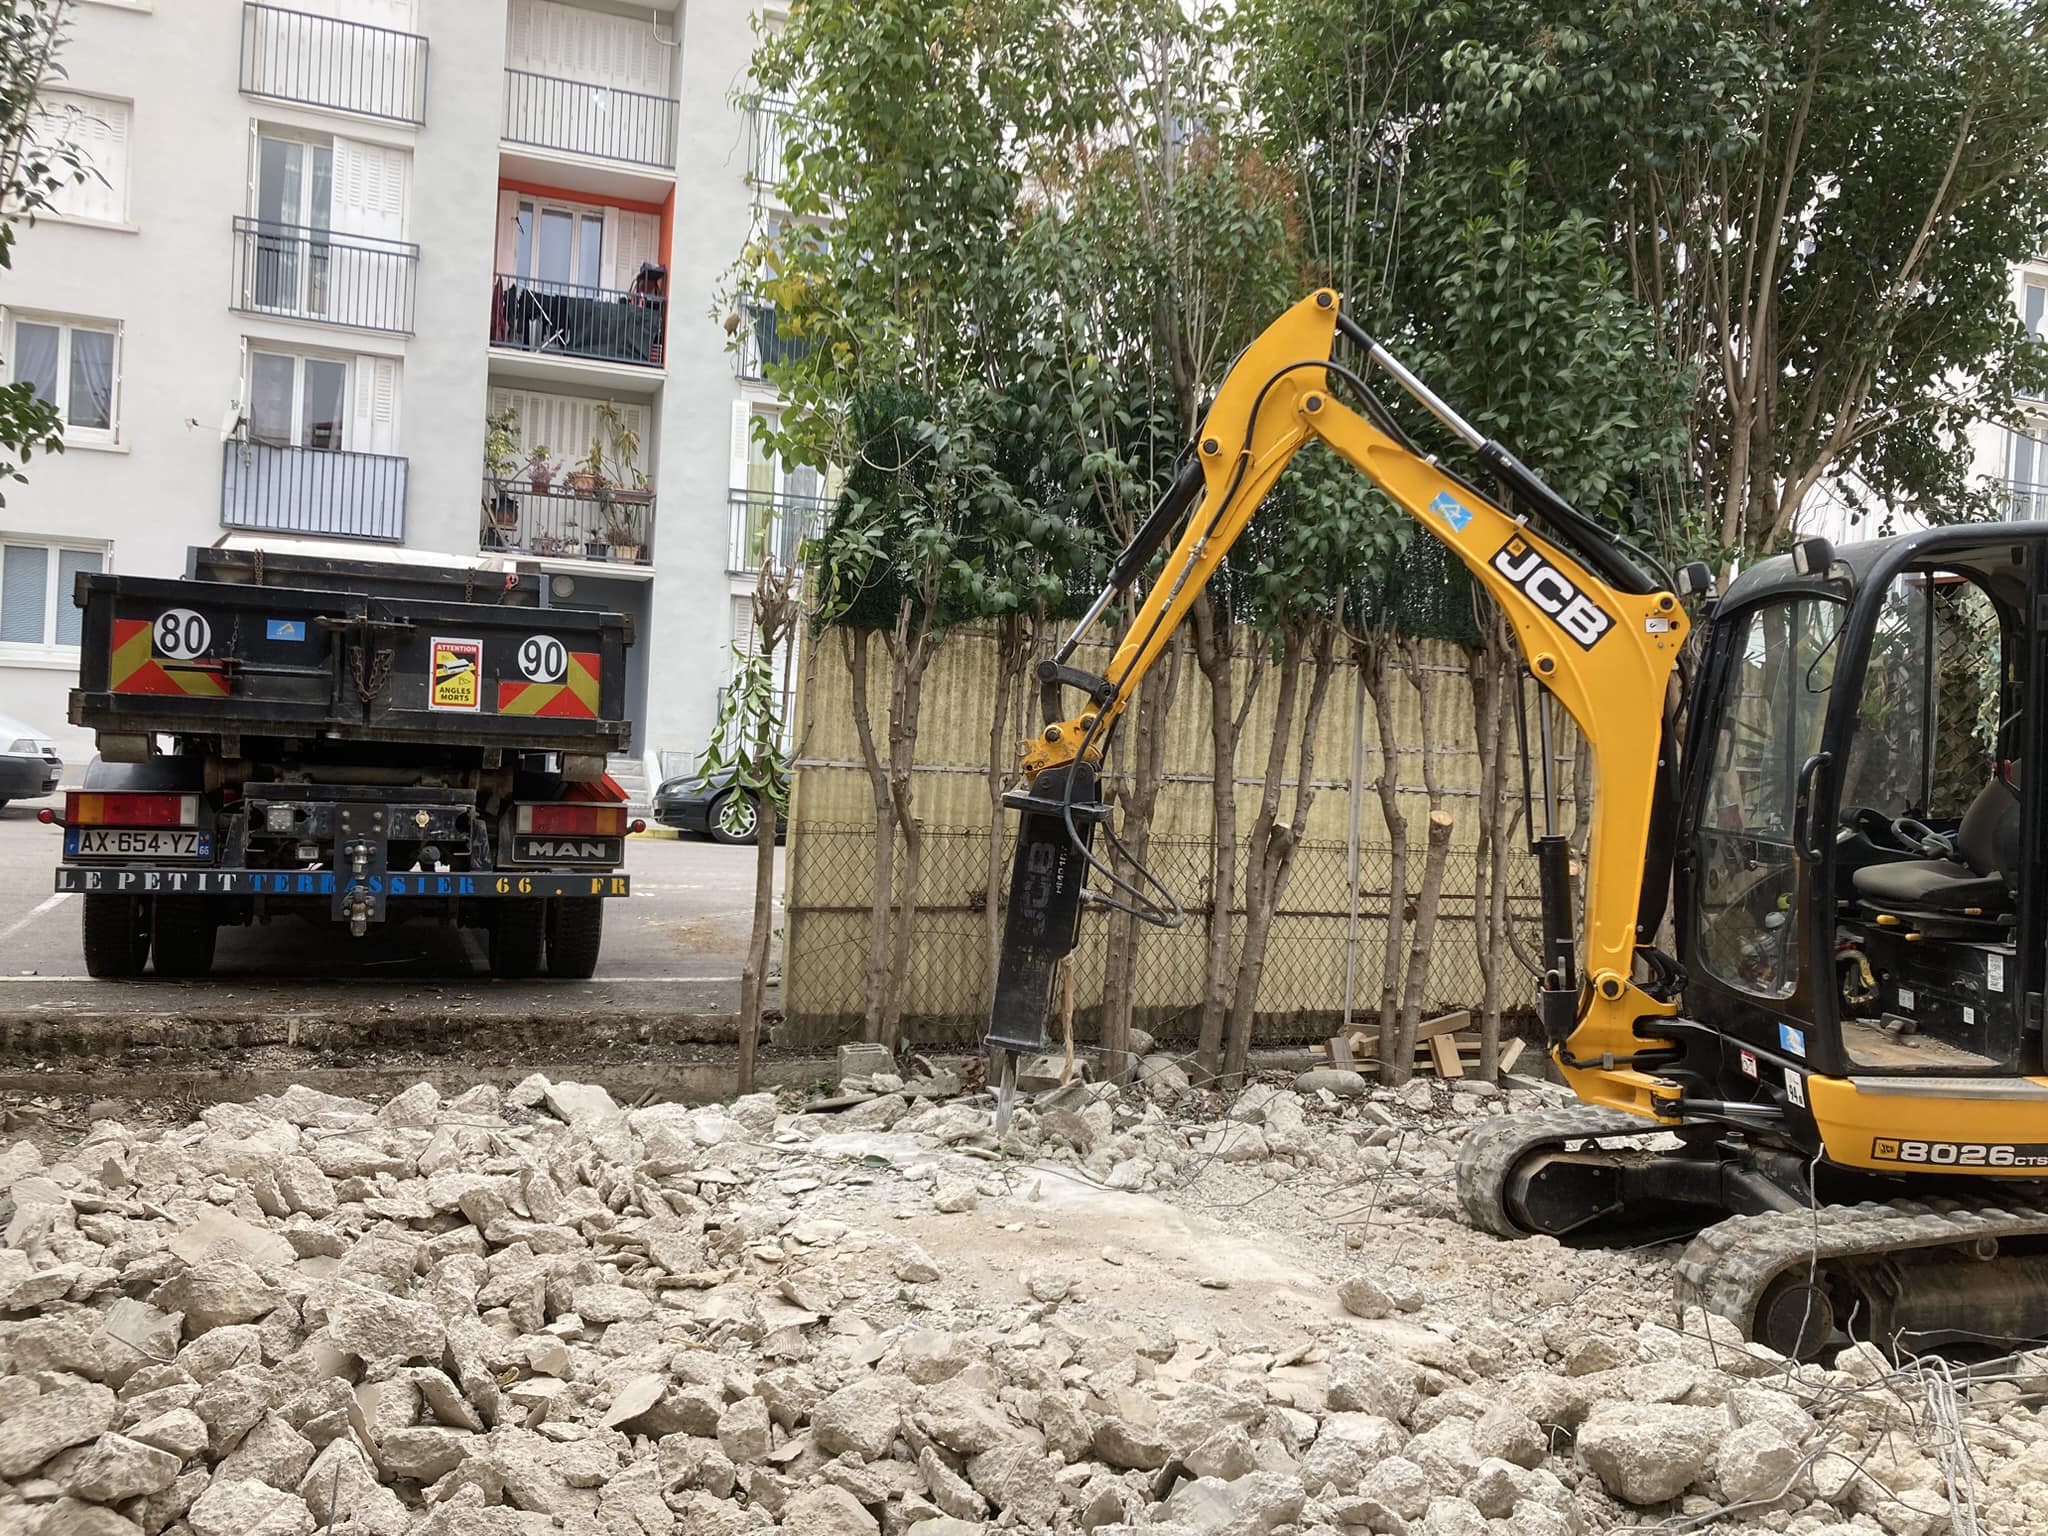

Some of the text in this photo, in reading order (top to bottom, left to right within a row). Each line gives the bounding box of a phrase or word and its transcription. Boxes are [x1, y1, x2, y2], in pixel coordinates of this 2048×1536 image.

[1495, 551, 1609, 645] JCB
[160, 613, 205, 654] 80
[436, 645, 477, 653] ATTENTION
[523, 640, 563, 678] 90
[440, 687, 471, 695] ANGLES
[80, 831, 198, 853] AX-654-YZ
[528, 841, 606, 858] MAN
[58, 871, 102, 890] LE
[117, 872, 237, 891] PETIT
